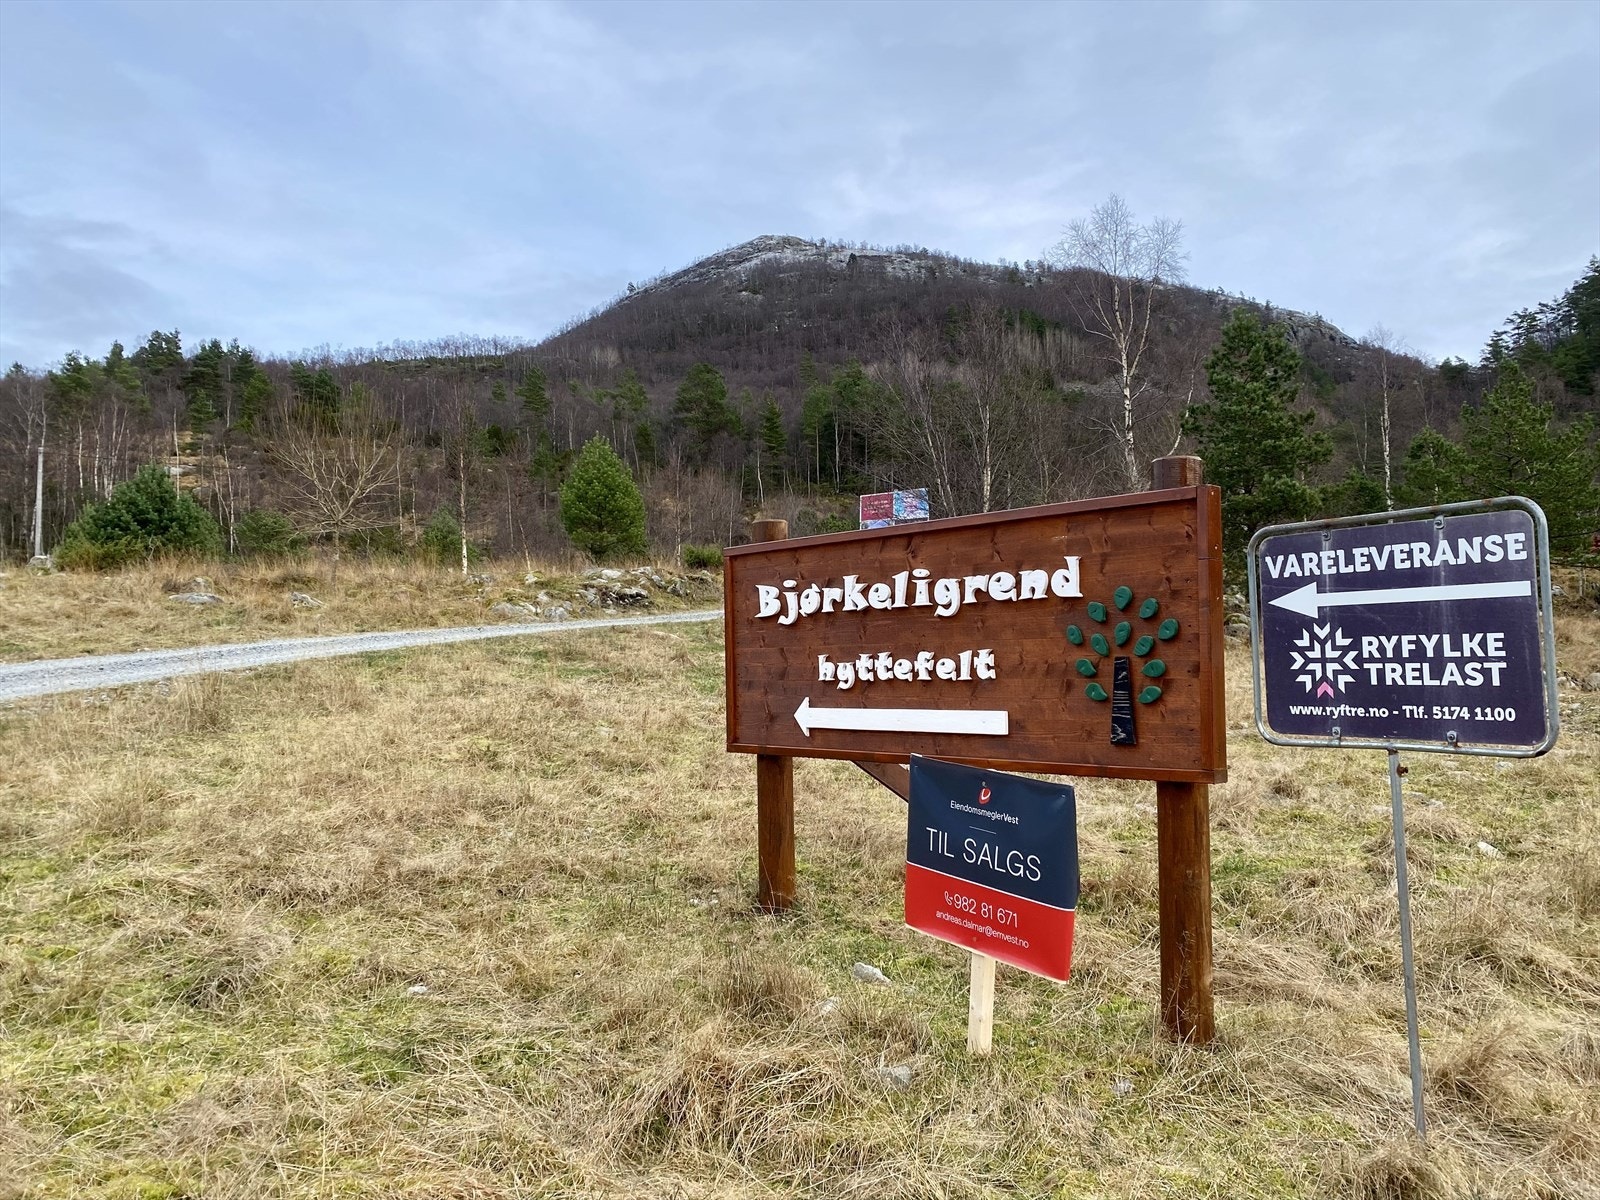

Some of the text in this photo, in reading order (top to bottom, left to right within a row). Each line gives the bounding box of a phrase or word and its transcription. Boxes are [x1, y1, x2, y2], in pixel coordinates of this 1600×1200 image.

[1265, 532, 1528, 579] VARELEVERANSE
[755, 556, 1083, 625] Bjørkeligrend
[1361, 633, 1506, 658] RYFYLKE
[817, 648, 996, 690] hyttefelt
[1363, 662, 1507, 687] TRELAST
[1289, 704, 1389, 719] www.ryftre.no
[1402, 705, 1428, 719] Tlf.
[1432, 706, 1470, 721] 5174
[1474, 707, 1516, 722] 1100
[950, 800, 1019, 825] EiendomsmeglerVest
[926, 826, 1041, 882] TIL SALGS
[954, 894, 1018, 928] 982 81 671
[935, 910, 1029, 949] andreas.dalmar@emvest.no
